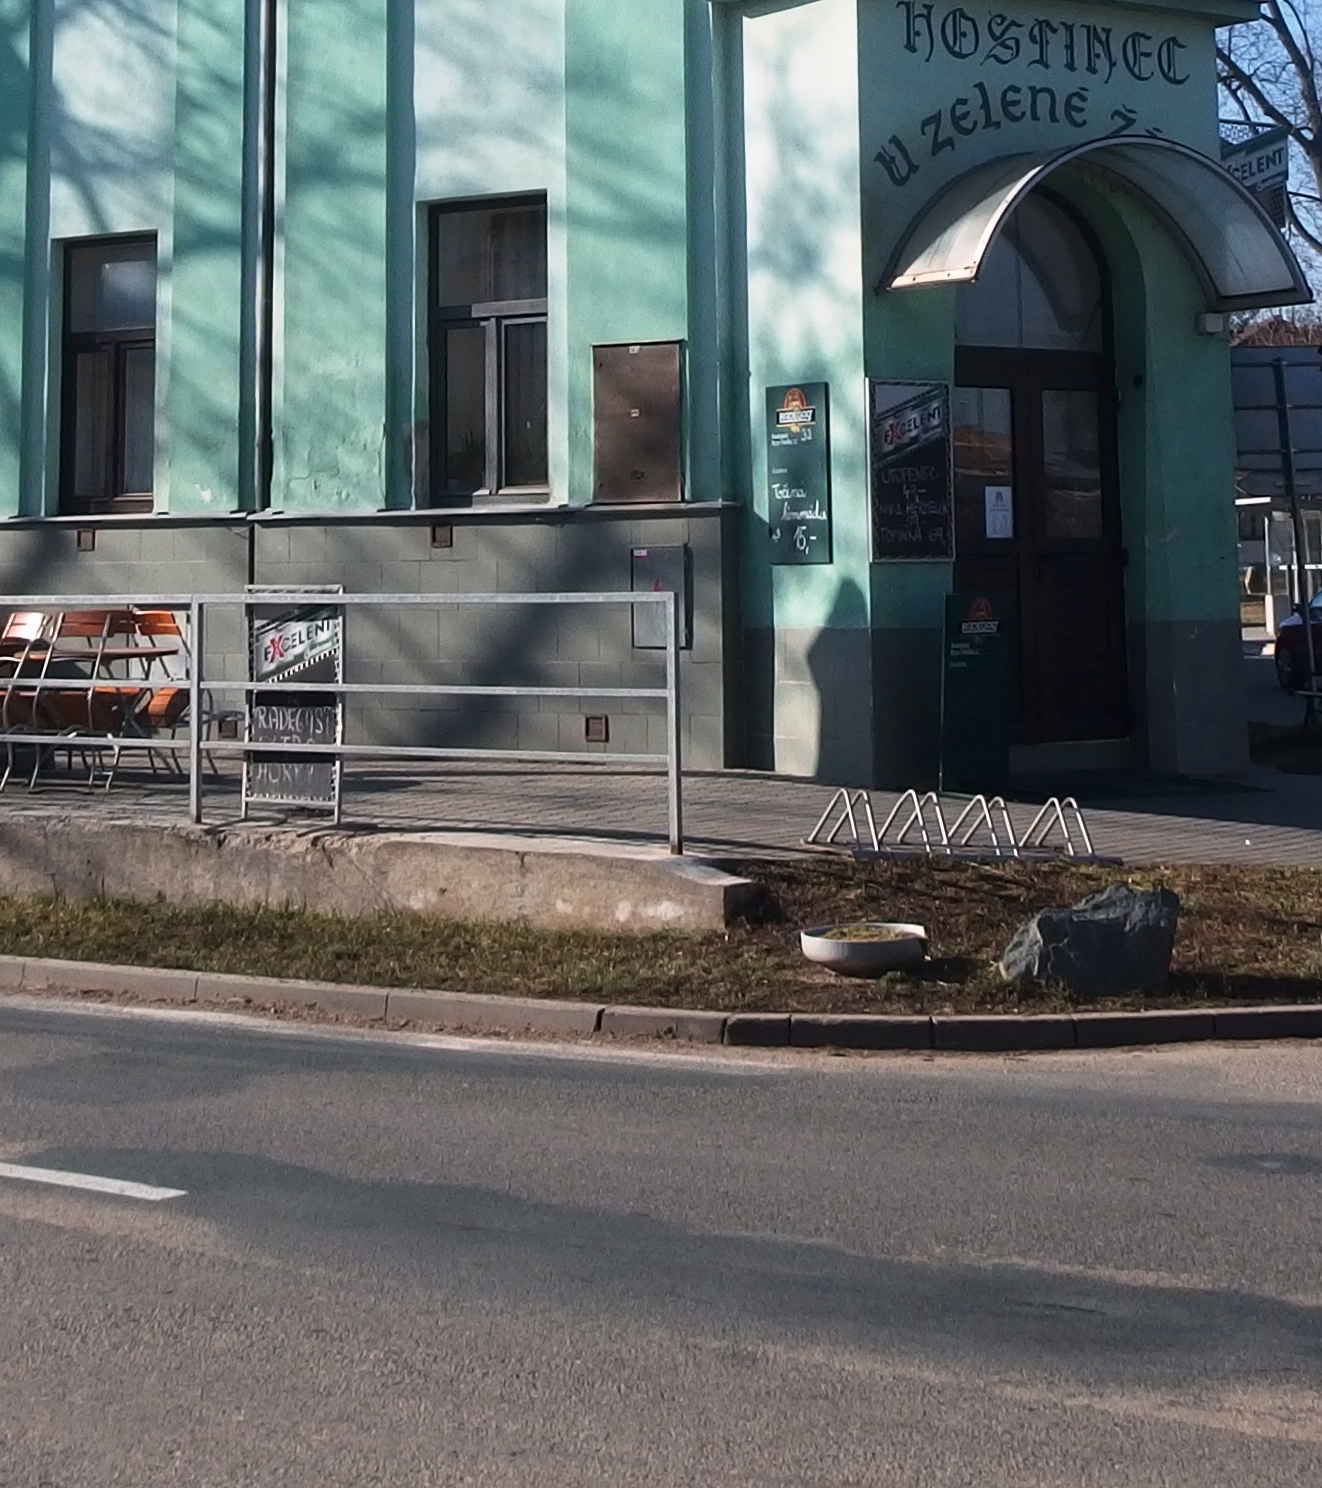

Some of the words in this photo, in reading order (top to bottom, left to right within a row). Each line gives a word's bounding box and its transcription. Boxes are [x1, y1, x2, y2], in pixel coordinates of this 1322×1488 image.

[895, 0, 1191, 86] HOSTINEC
[874, 133, 920, 188] U
[883, 406, 942, 445] EXCELENT
[263, 619, 331, 663] EXCELENT
